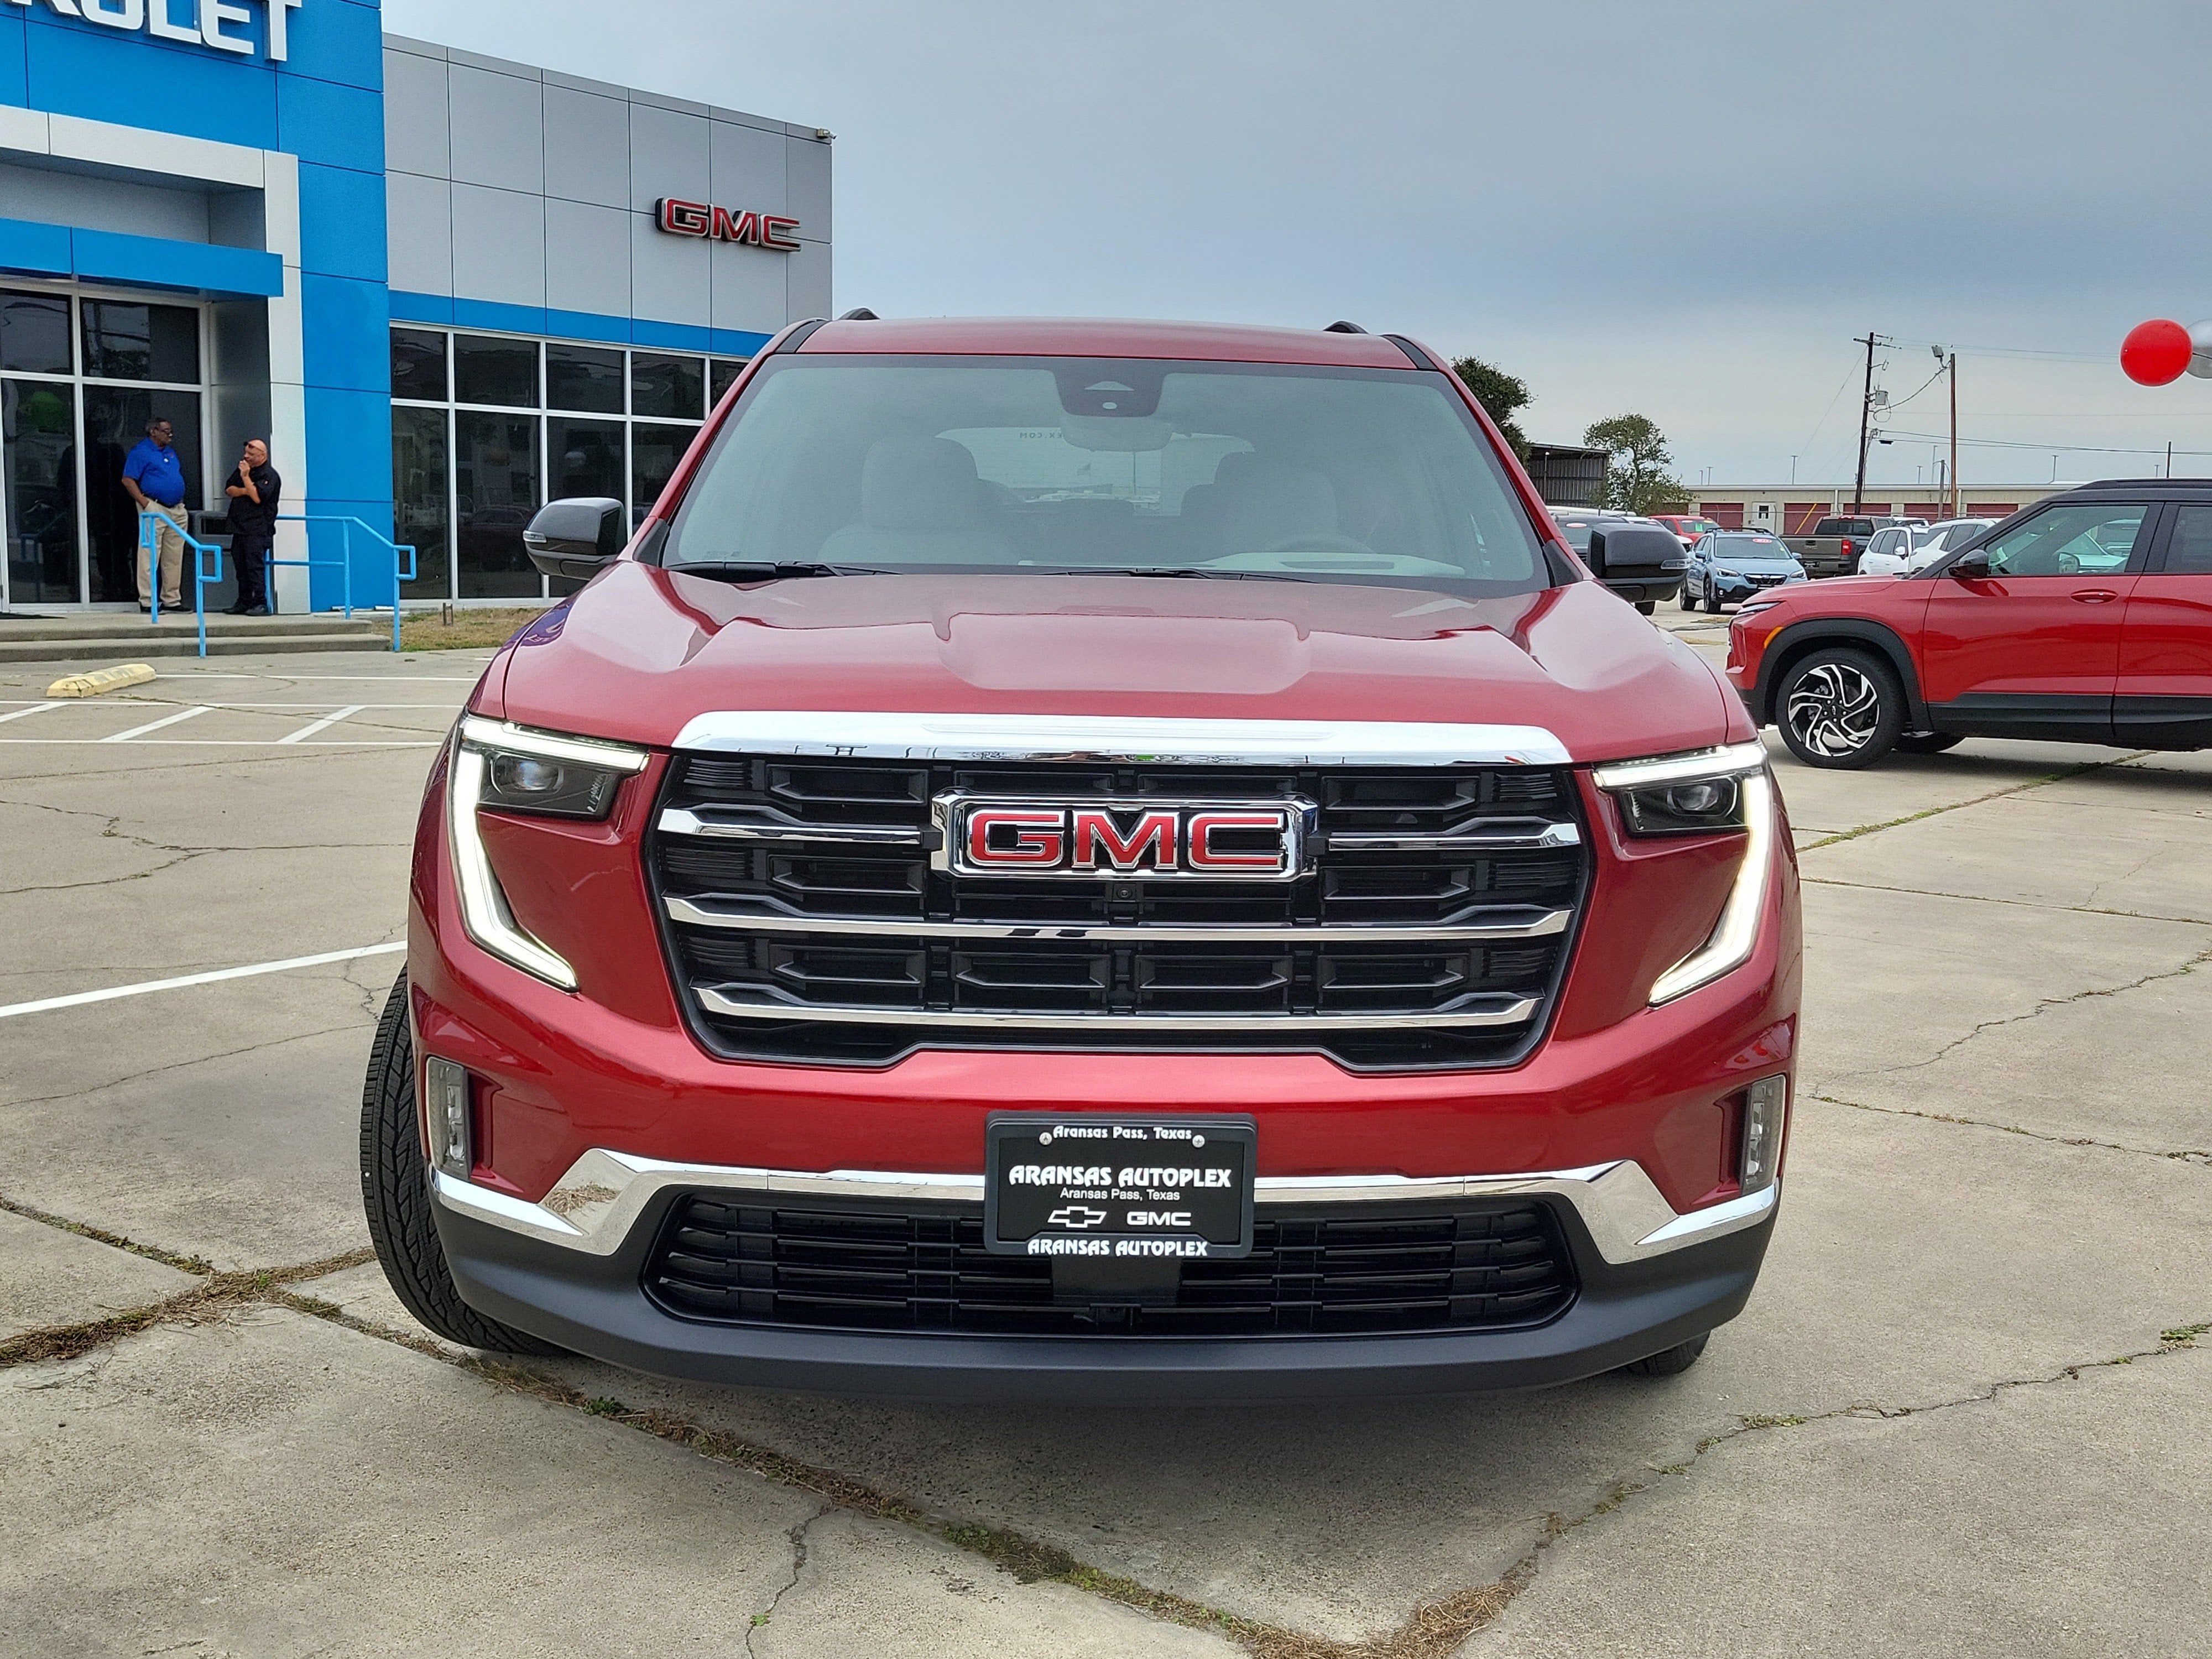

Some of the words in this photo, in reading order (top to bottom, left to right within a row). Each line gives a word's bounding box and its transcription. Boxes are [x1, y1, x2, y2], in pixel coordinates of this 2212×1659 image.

[655, 197, 801, 252] GMC
[967, 809, 1284, 869] GMC
[1052, 1125, 1108, 1139] Aransas
[1113, 1126, 1147, 1140] Pass,
[1153, 1127, 1192, 1140] Texas
[1009, 1165, 1112, 1187] ARANSAS
[1118, 1168, 1232, 1188] AUTOPLEX
[1060, 1187, 1107, 1199] Aransas
[1111, 1189, 1142, 1202] Pass,
[1146, 1190, 1180, 1201] Texas
[1126, 1212, 1191, 1227] GMC
[1027, 1239, 1110, 1256] ARANSAS
[1115, 1241, 1208, 1257] AUTOPLEX
